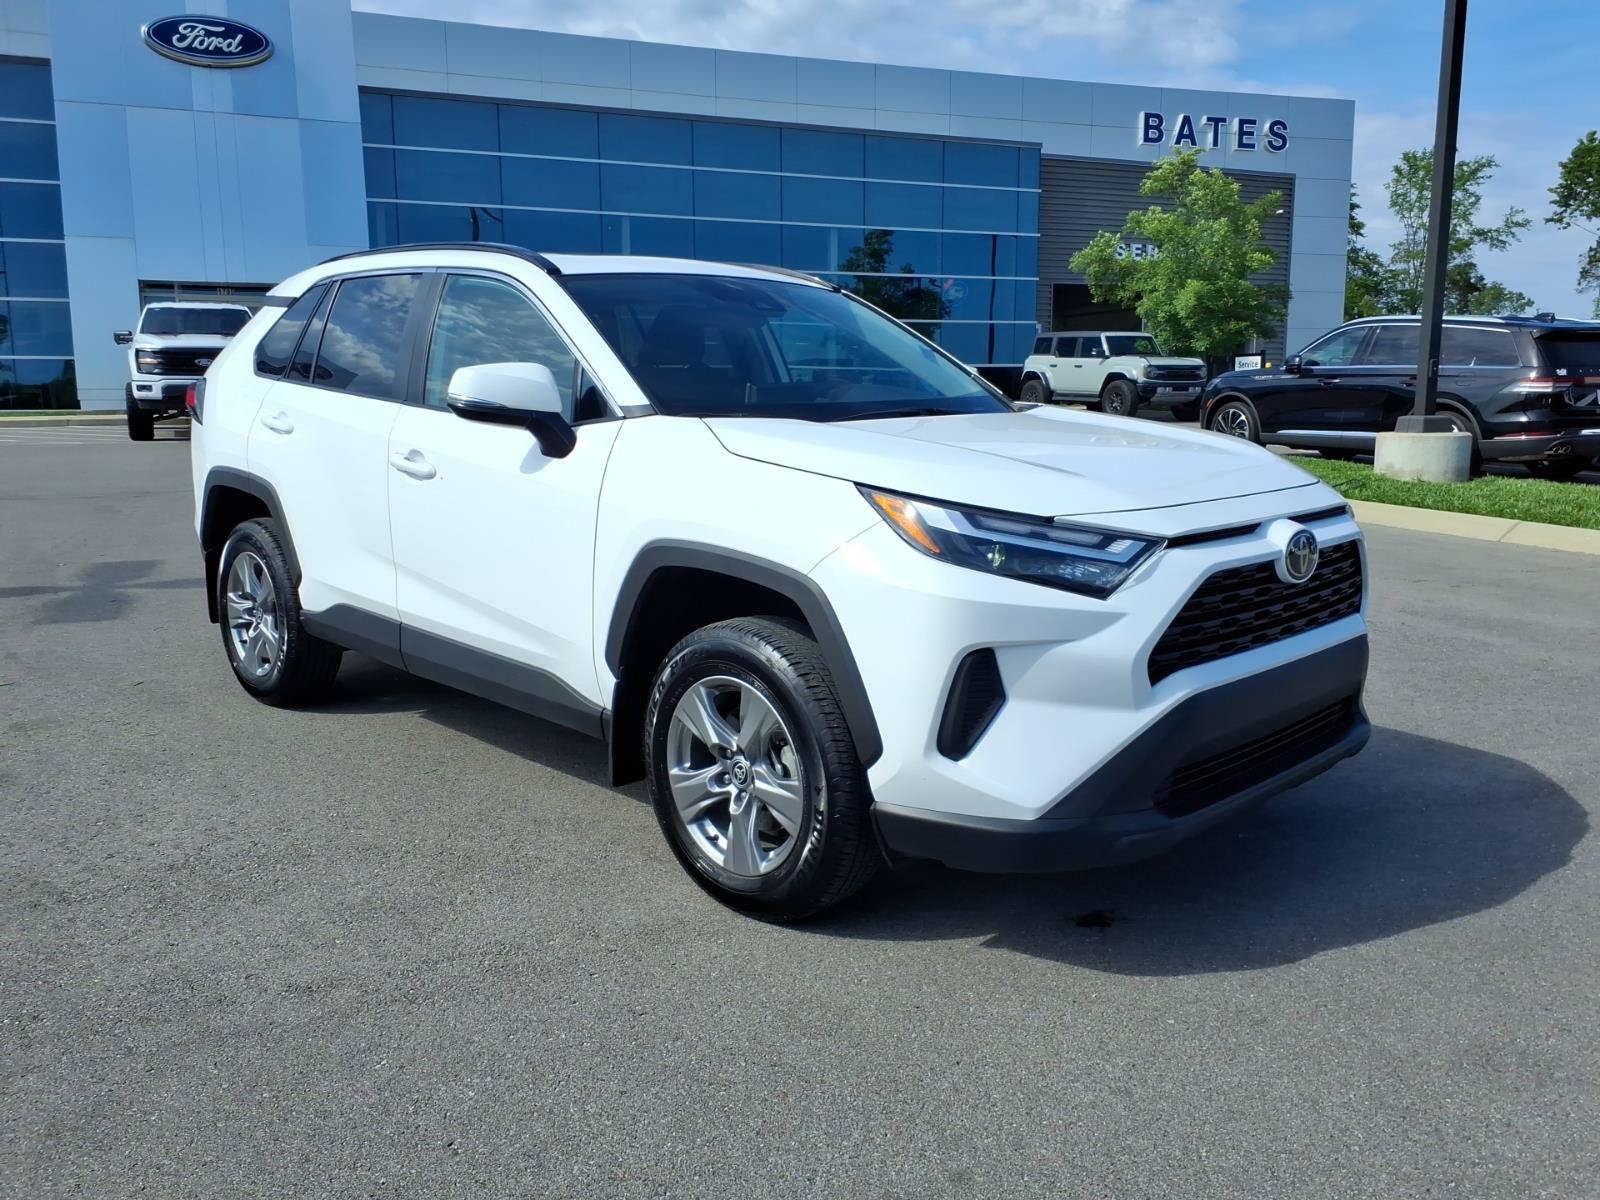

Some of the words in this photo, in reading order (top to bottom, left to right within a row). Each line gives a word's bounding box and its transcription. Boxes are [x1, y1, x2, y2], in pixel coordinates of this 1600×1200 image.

[172, 22, 244, 54] Ford
[1138, 111, 1289, 153] BATES
[1238, 359, 1259, 369] Service
